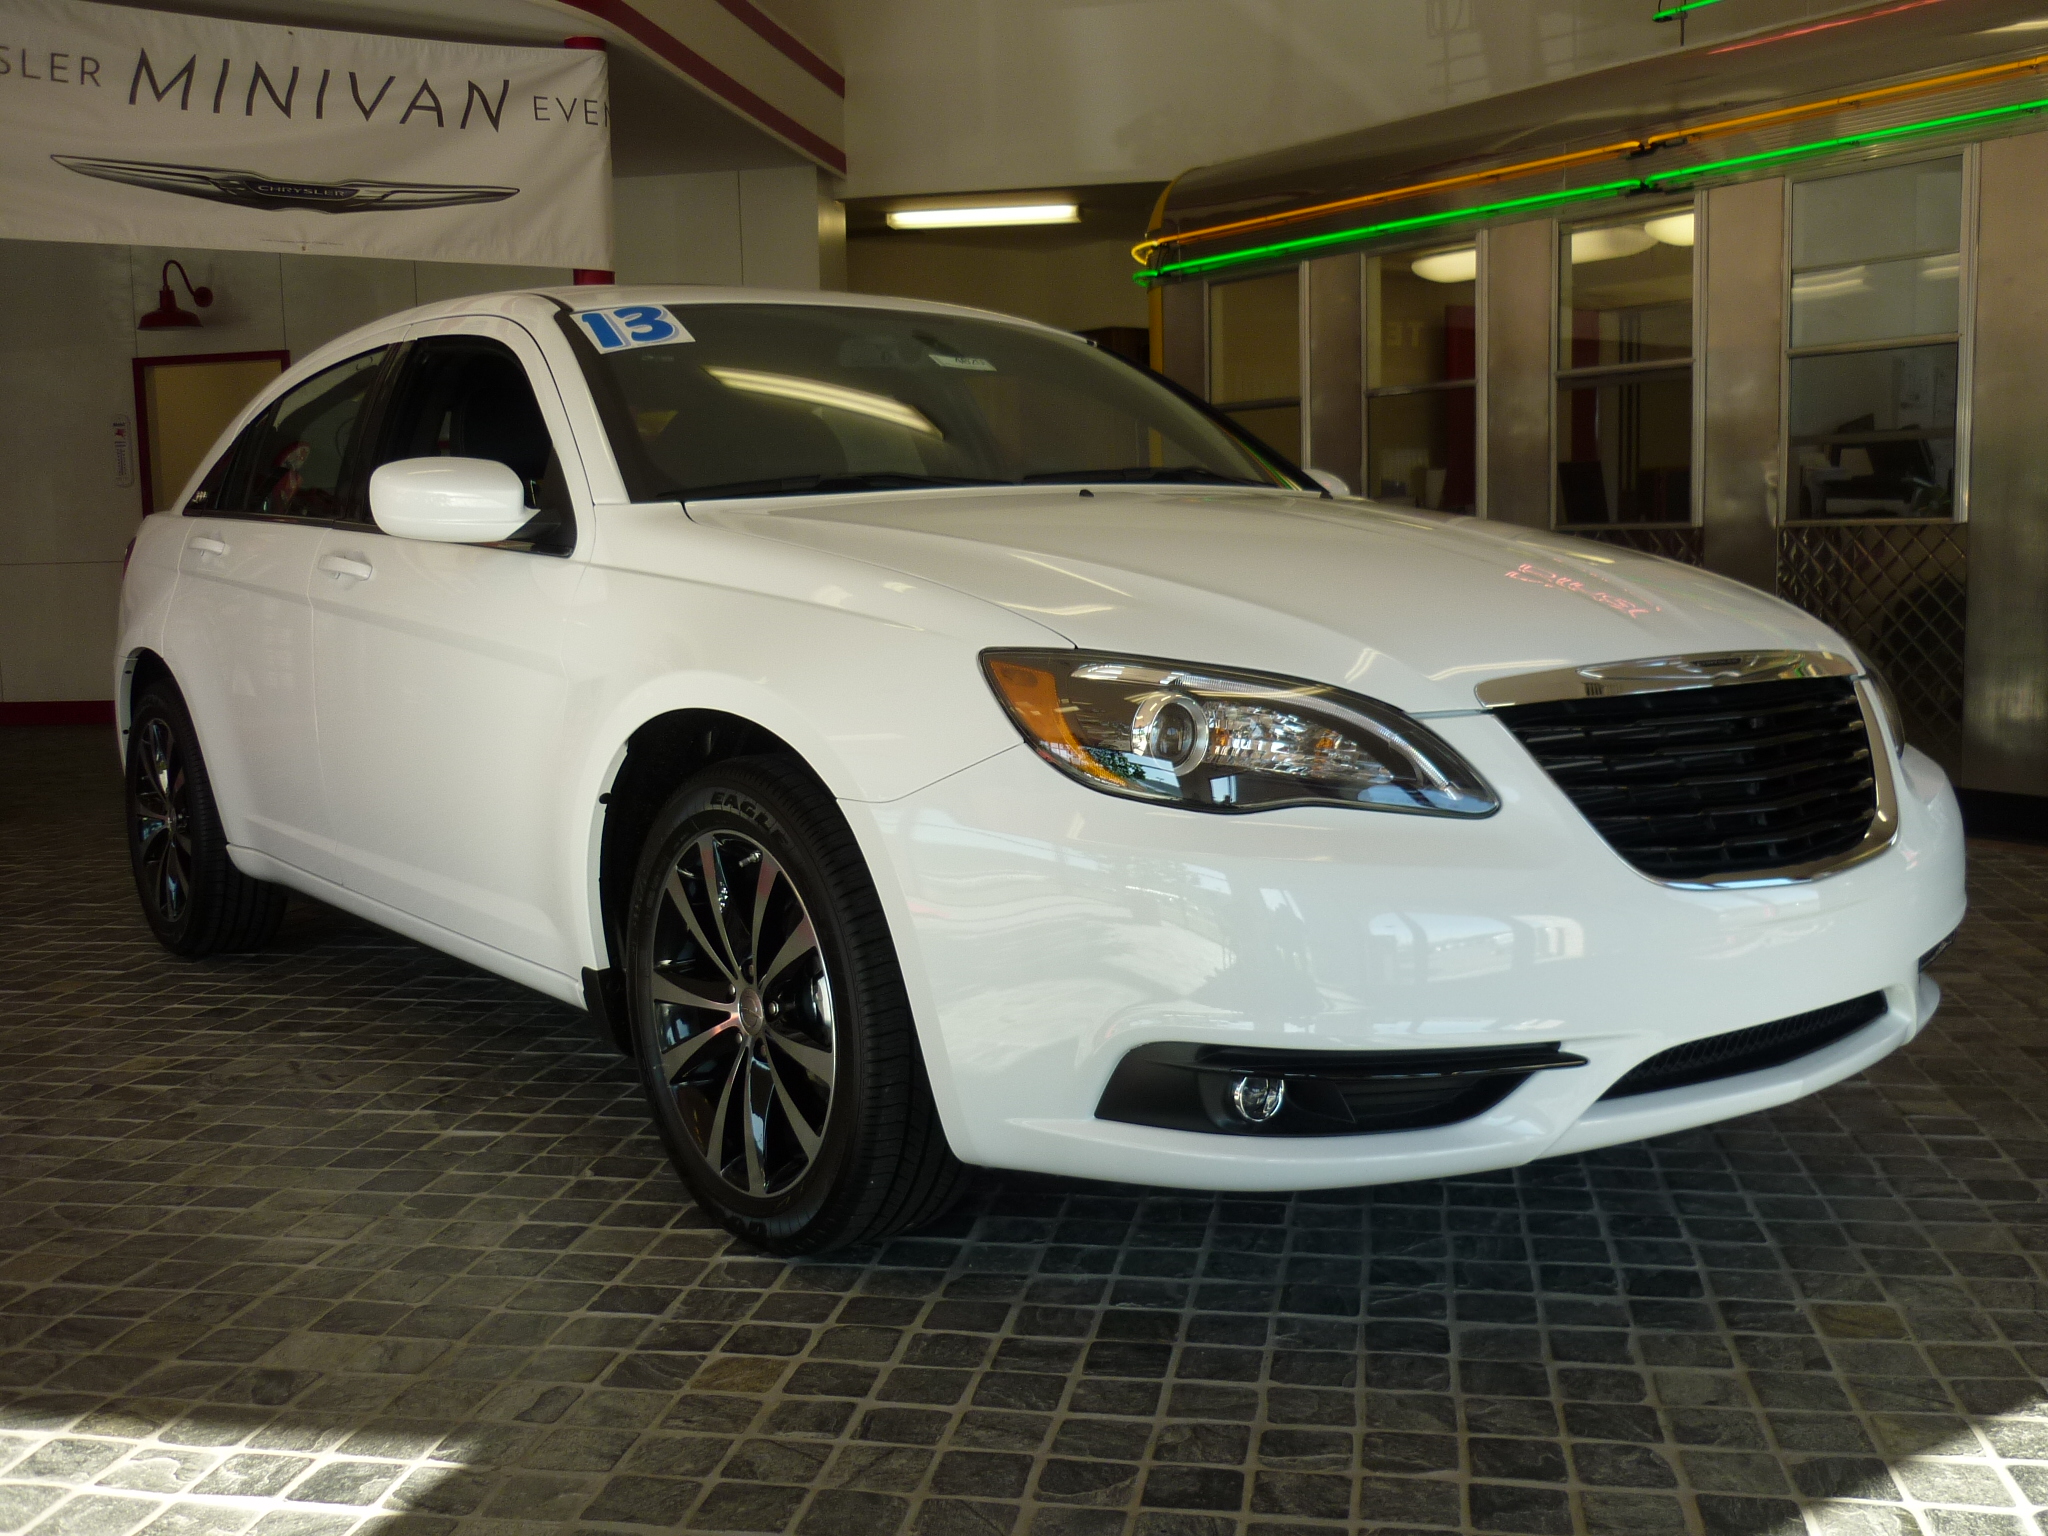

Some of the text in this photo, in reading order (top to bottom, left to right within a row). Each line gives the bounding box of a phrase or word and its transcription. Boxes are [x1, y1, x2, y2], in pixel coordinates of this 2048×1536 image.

[129, 48, 510, 132] MINIVAN
[258, 185, 345, 197] CHRYSLER
[581, 306, 676, 349] 13
